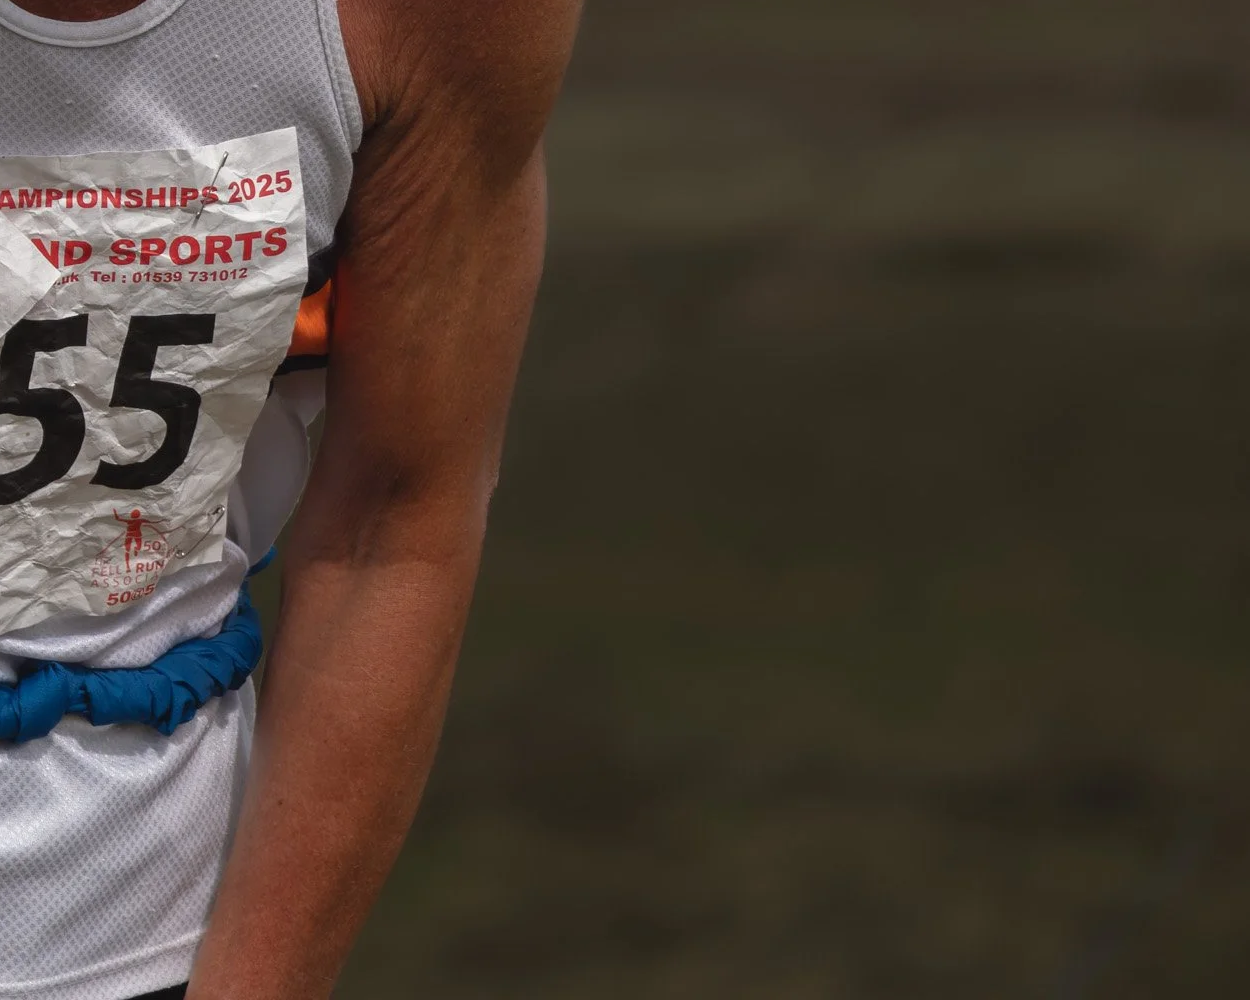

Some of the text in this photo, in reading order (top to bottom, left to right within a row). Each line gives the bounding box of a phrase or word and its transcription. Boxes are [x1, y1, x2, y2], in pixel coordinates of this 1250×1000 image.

[228, 169, 294, 204] 2025
[108, 227, 288, 266] SPORTS
[90, 271, 116, 283] Tel
[132, 271, 182, 284] 01539
[188, 267, 248, 283] 731012
